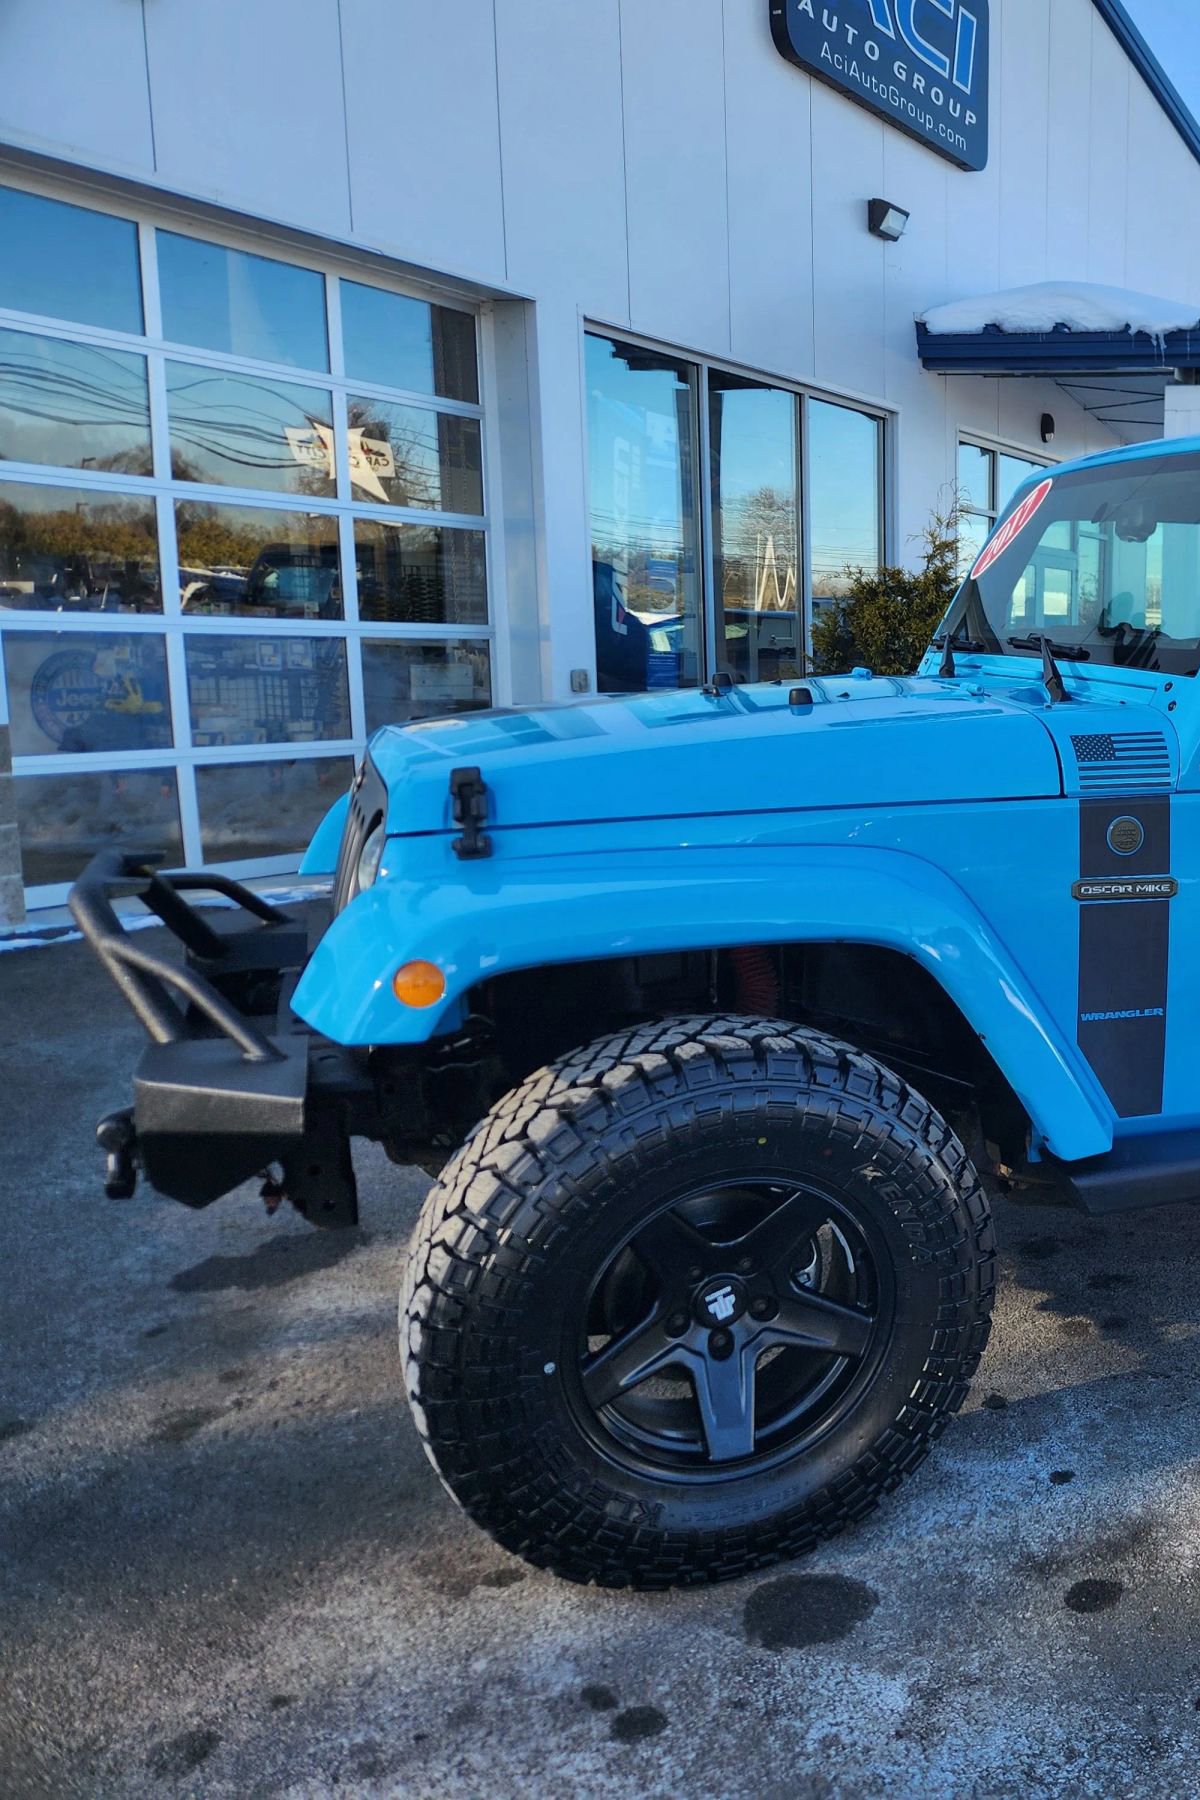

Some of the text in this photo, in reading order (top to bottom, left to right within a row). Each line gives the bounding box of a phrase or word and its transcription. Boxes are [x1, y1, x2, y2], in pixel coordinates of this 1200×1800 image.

[797, 0, 977, 126] AUTO GROUP
[820, 41, 967, 151] AciAutoGroup.com
[980, 490, 1039, 571] 2017
[1081, 884, 1171, 894] OSCAR MIKE
[1080, 1008, 1164, 1021] WRANGLER
[851, 1161, 936, 1265] KENDA
